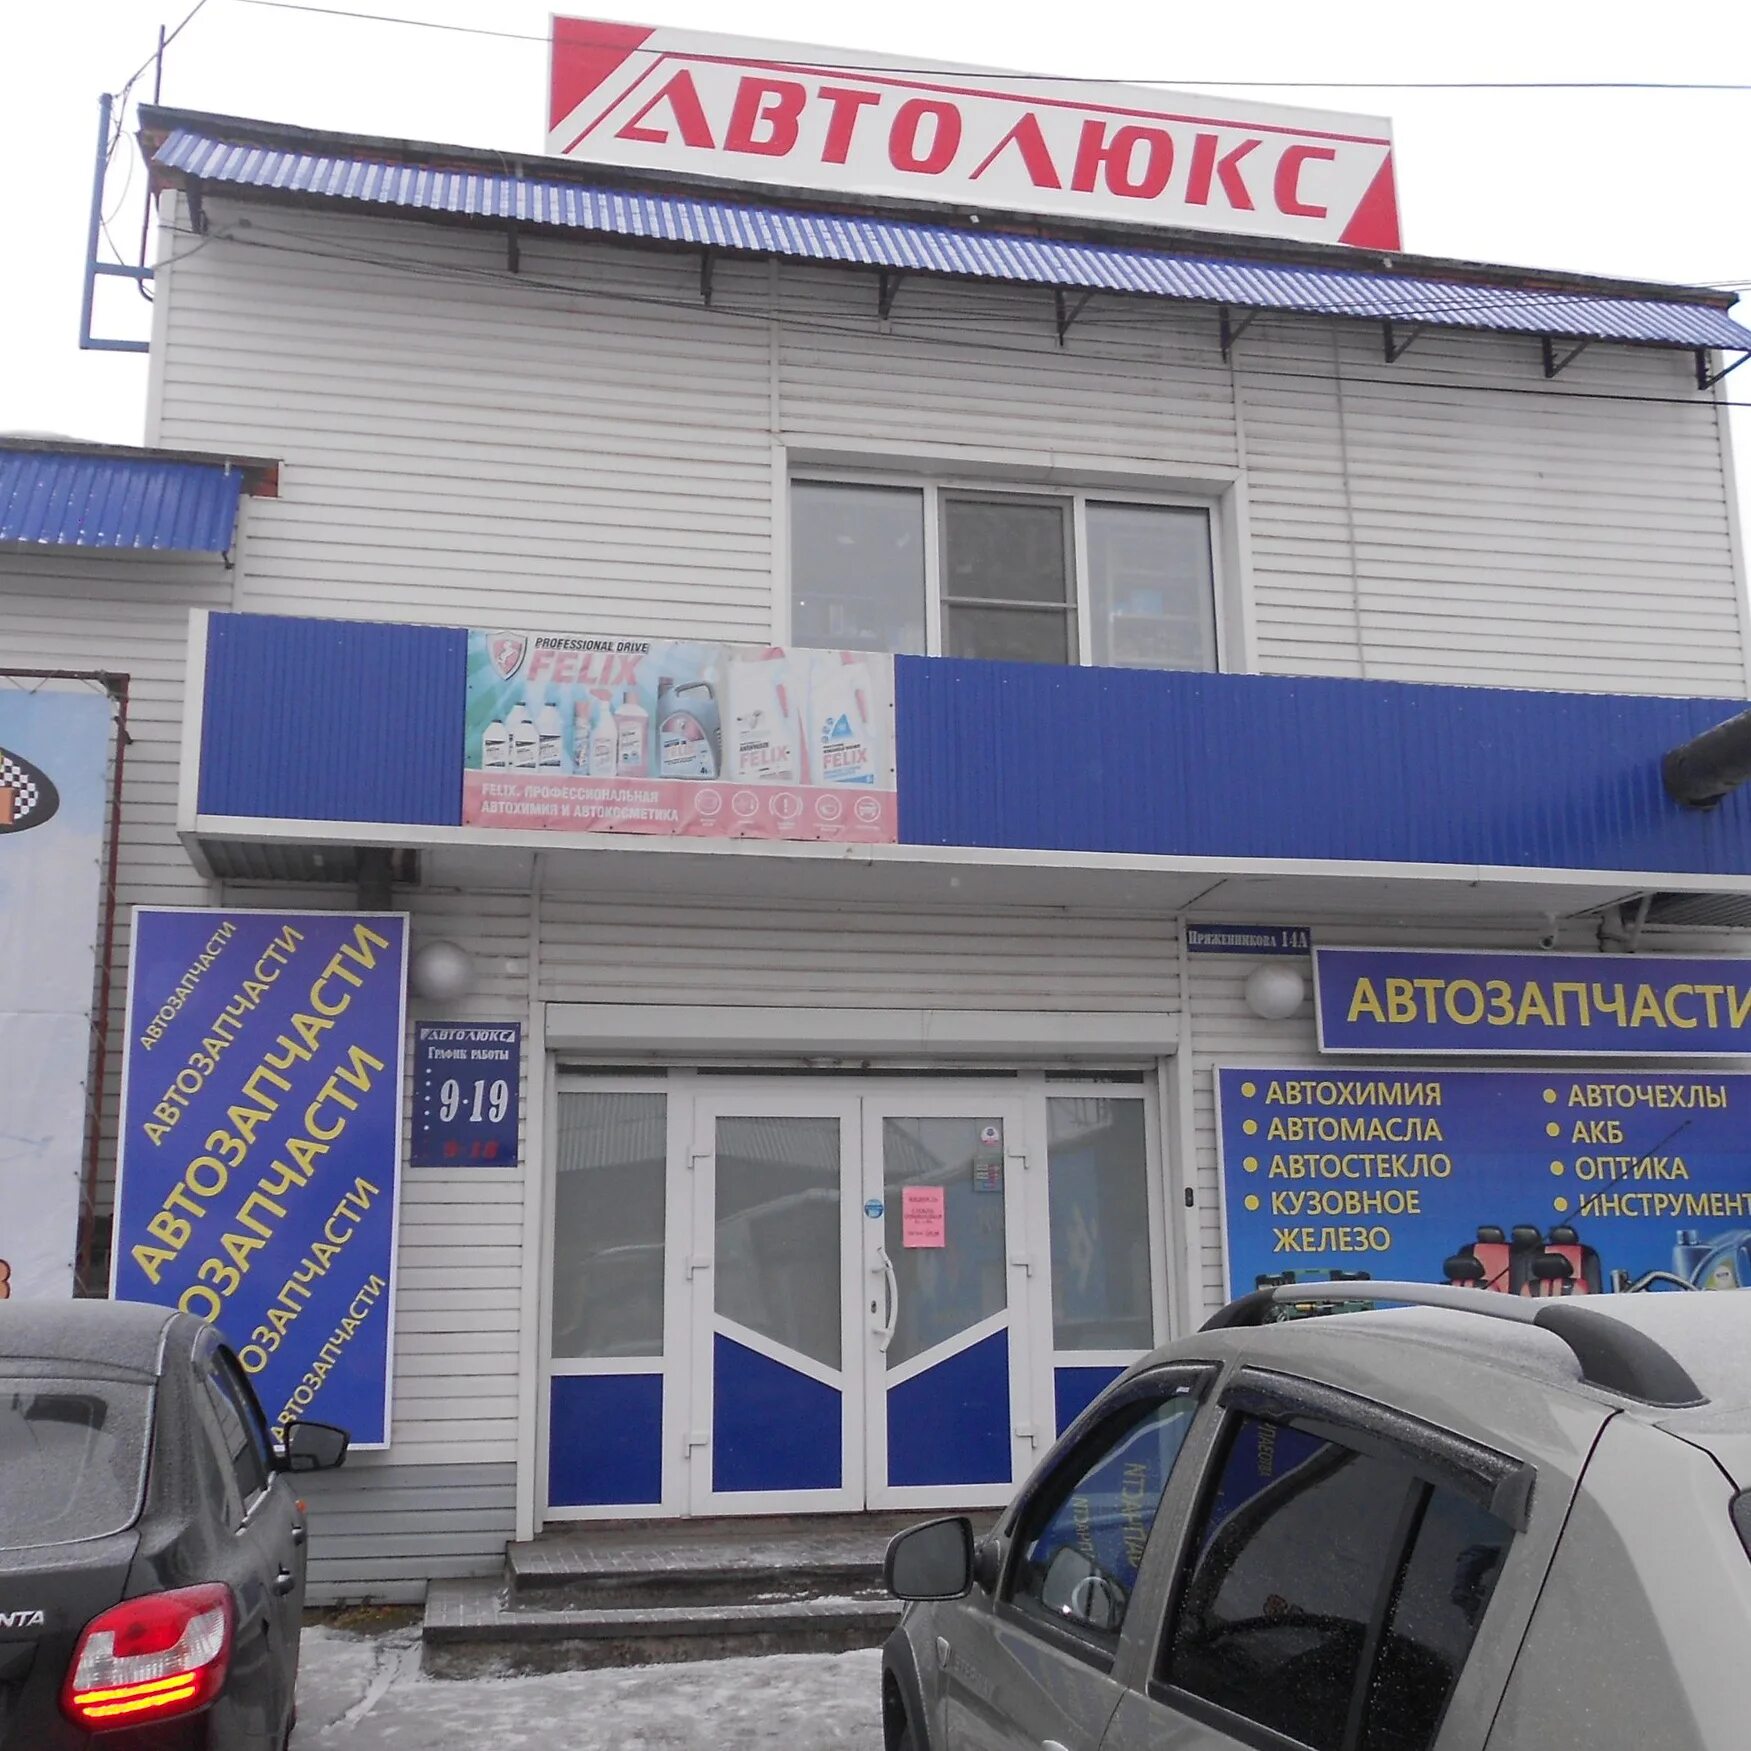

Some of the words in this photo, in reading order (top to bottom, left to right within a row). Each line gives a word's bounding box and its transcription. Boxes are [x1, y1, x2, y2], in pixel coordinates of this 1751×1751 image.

[614, 69, 1338, 219] АВТОЛЮКС
[535, 637, 613, 651] PROFESSIONAL
[616, 642, 649, 654] DRIVE
[527, 651, 643, 686] FELIX
[739, 745, 790, 769] FELIX
[823, 747, 868, 769] FELIX
[525, 786, 659, 803] ПРОФЕССИОНАЛЬНАЯ
[481, 801, 558, 815] АВТОХИМИЯ
[561, 804, 570, 816] И
[574, 805, 679, 822] АВТОКОСМЕТИКА
[140, 921, 236, 1051] АВТОЗАПЧАСТИ
[1347, 977, 1751, 1030] АВТОЗАПЧАСТИ
[142, 924, 305, 1147] АВТОЗАПЧАСТИ
[427, 1029, 510, 1041] АВТОЛЮКС
[131, 923, 389, 1284] АВТОЗАПЧАСТИ
[1265, 1081, 1442, 1107] АВТОХИМИЯ
[1568, 1084, 1727, 1108] АВТОЧЕХЛЫ
[1267, 1118, 1443, 1143] АВТОМАСЛА
[1571, 1120, 1624, 1143] АКБ
[1268, 1154, 1451, 1179] АВТОСТЕКЛО
[1575, 1156, 1689, 1180] ОПТИКА
[1272, 1190, 1421, 1215] КУЗОВНОЕ
[1272, 1227, 1391, 1253] ЖЕЛЕЗО
[270, 1274, 386, 1444] АВТОЗАПЧАСТИ
